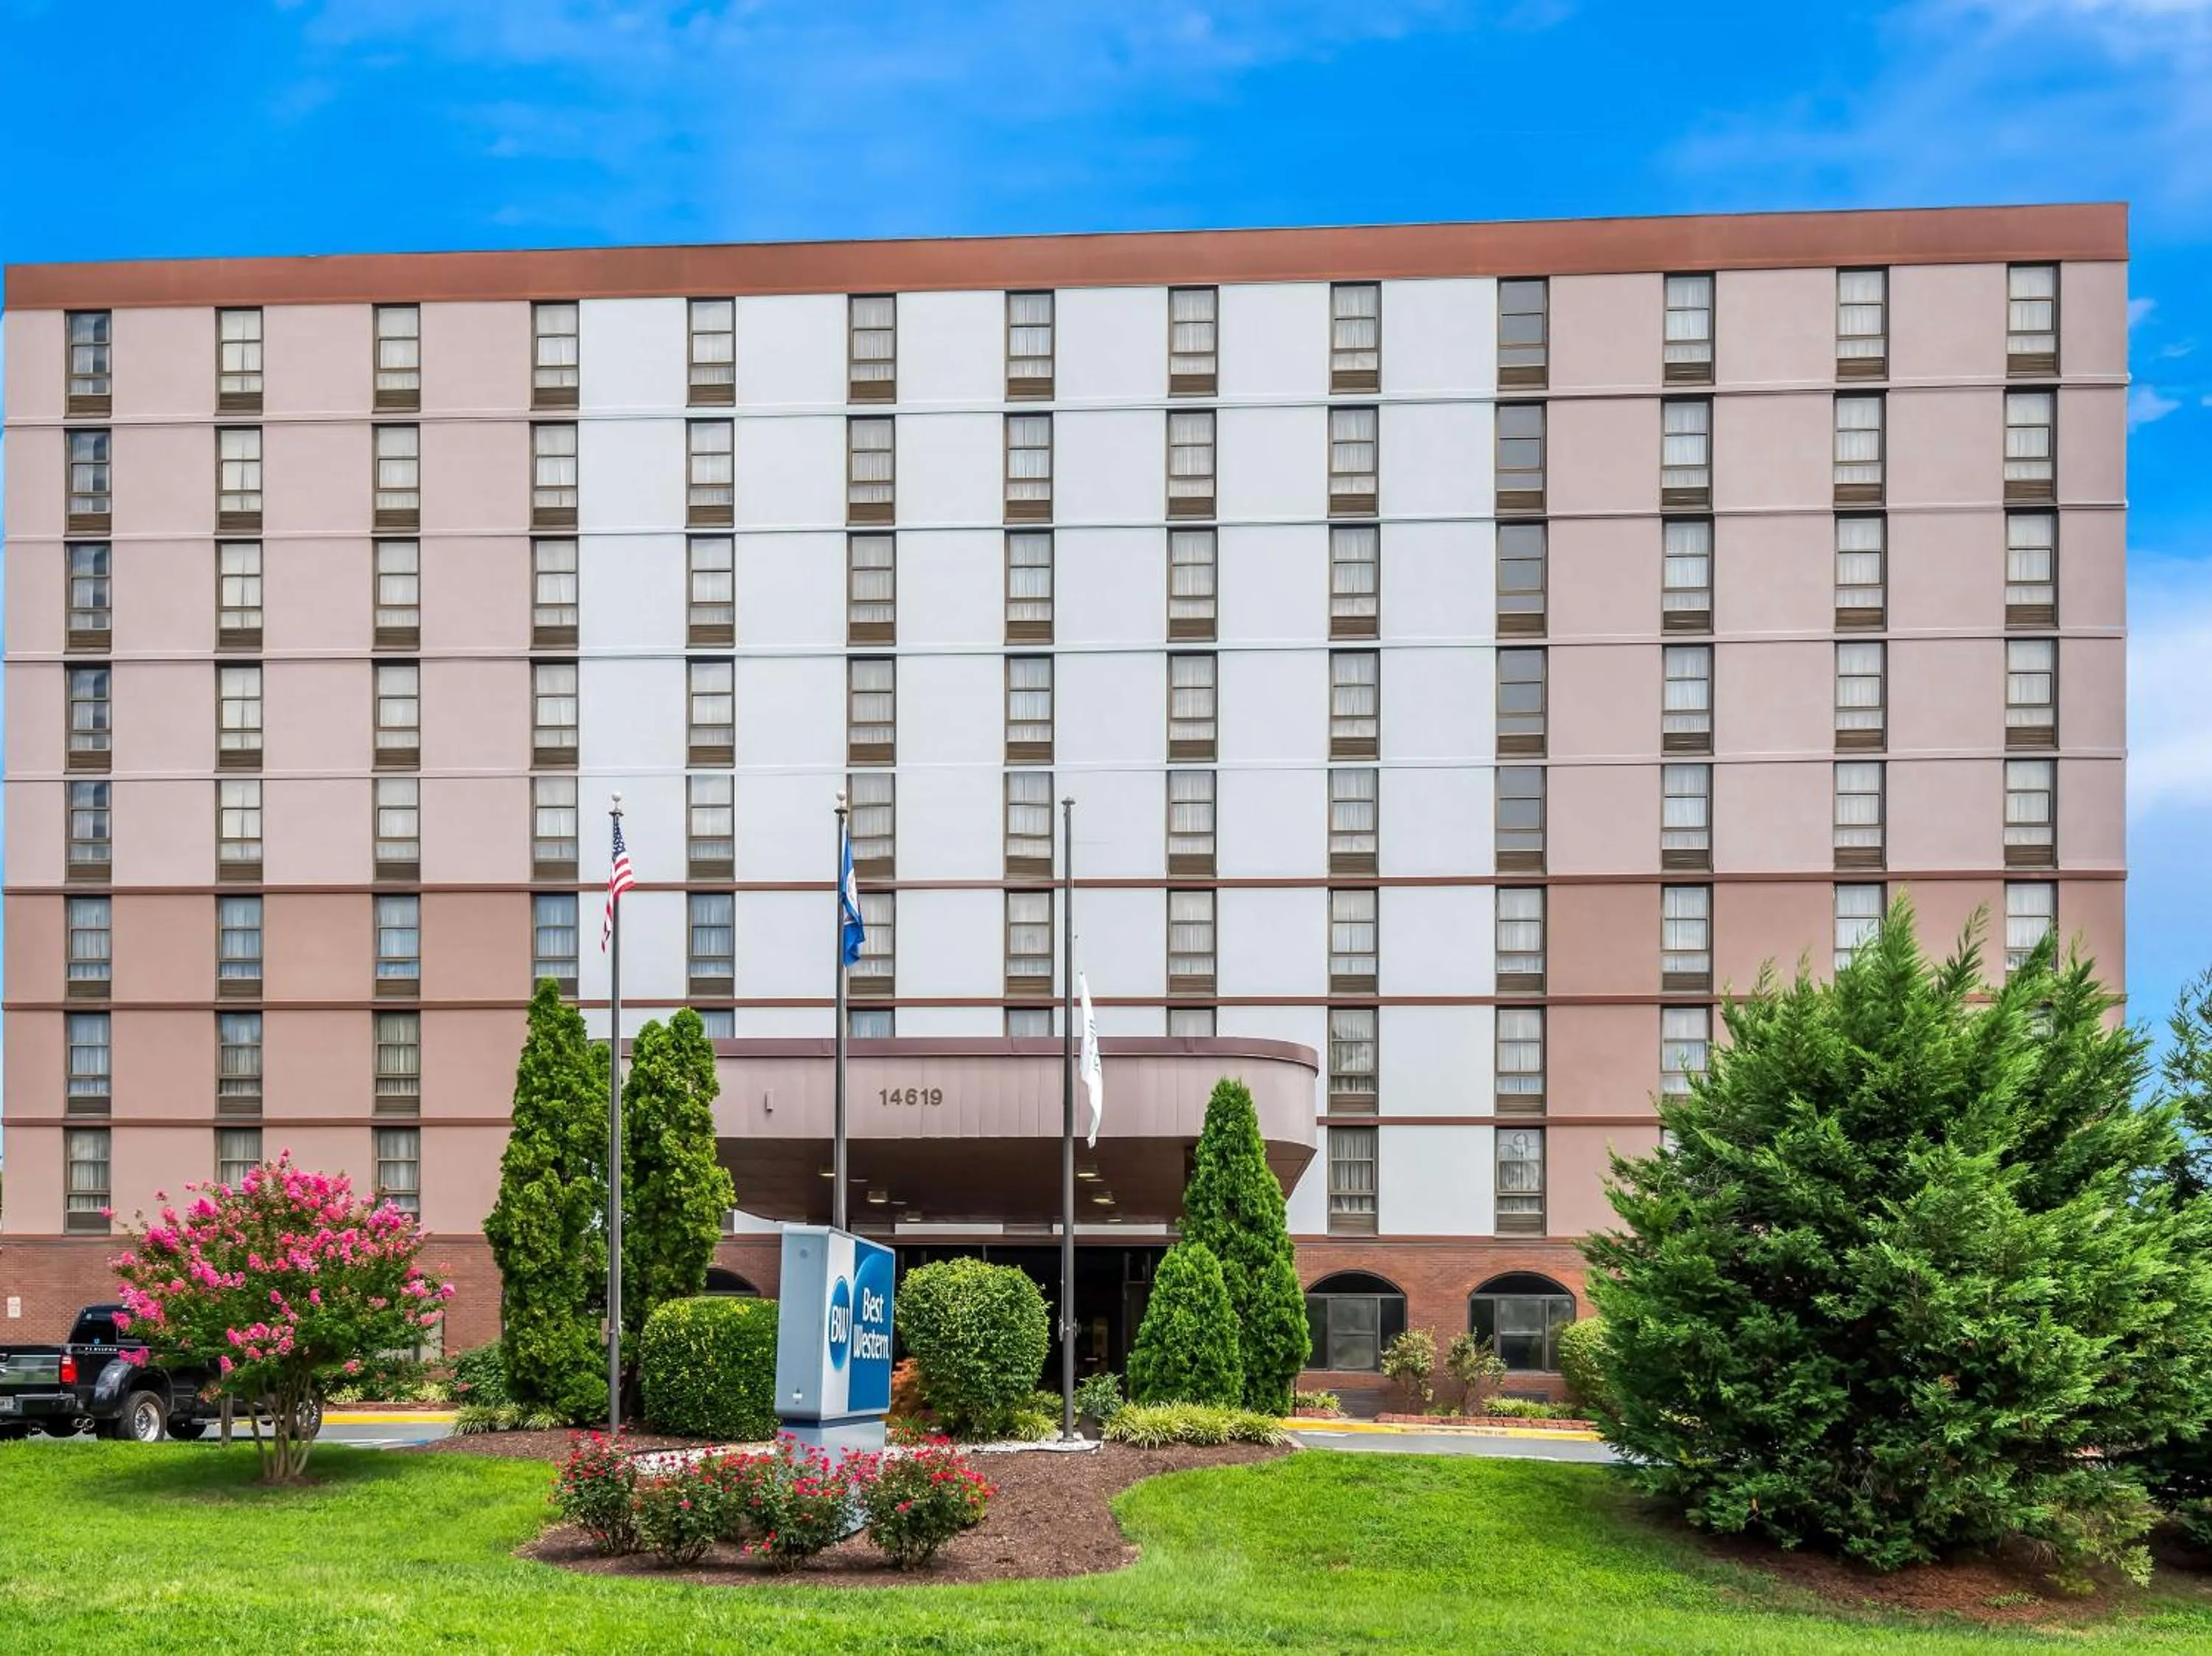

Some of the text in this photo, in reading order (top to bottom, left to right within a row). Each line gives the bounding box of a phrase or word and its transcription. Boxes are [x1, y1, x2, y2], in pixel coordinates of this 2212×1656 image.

[879, 1088, 943, 1106] 14619
[862, 1287, 884, 1323] Best
[830, 1305, 849, 1343] BW
[853, 1324, 889, 1360] Western
